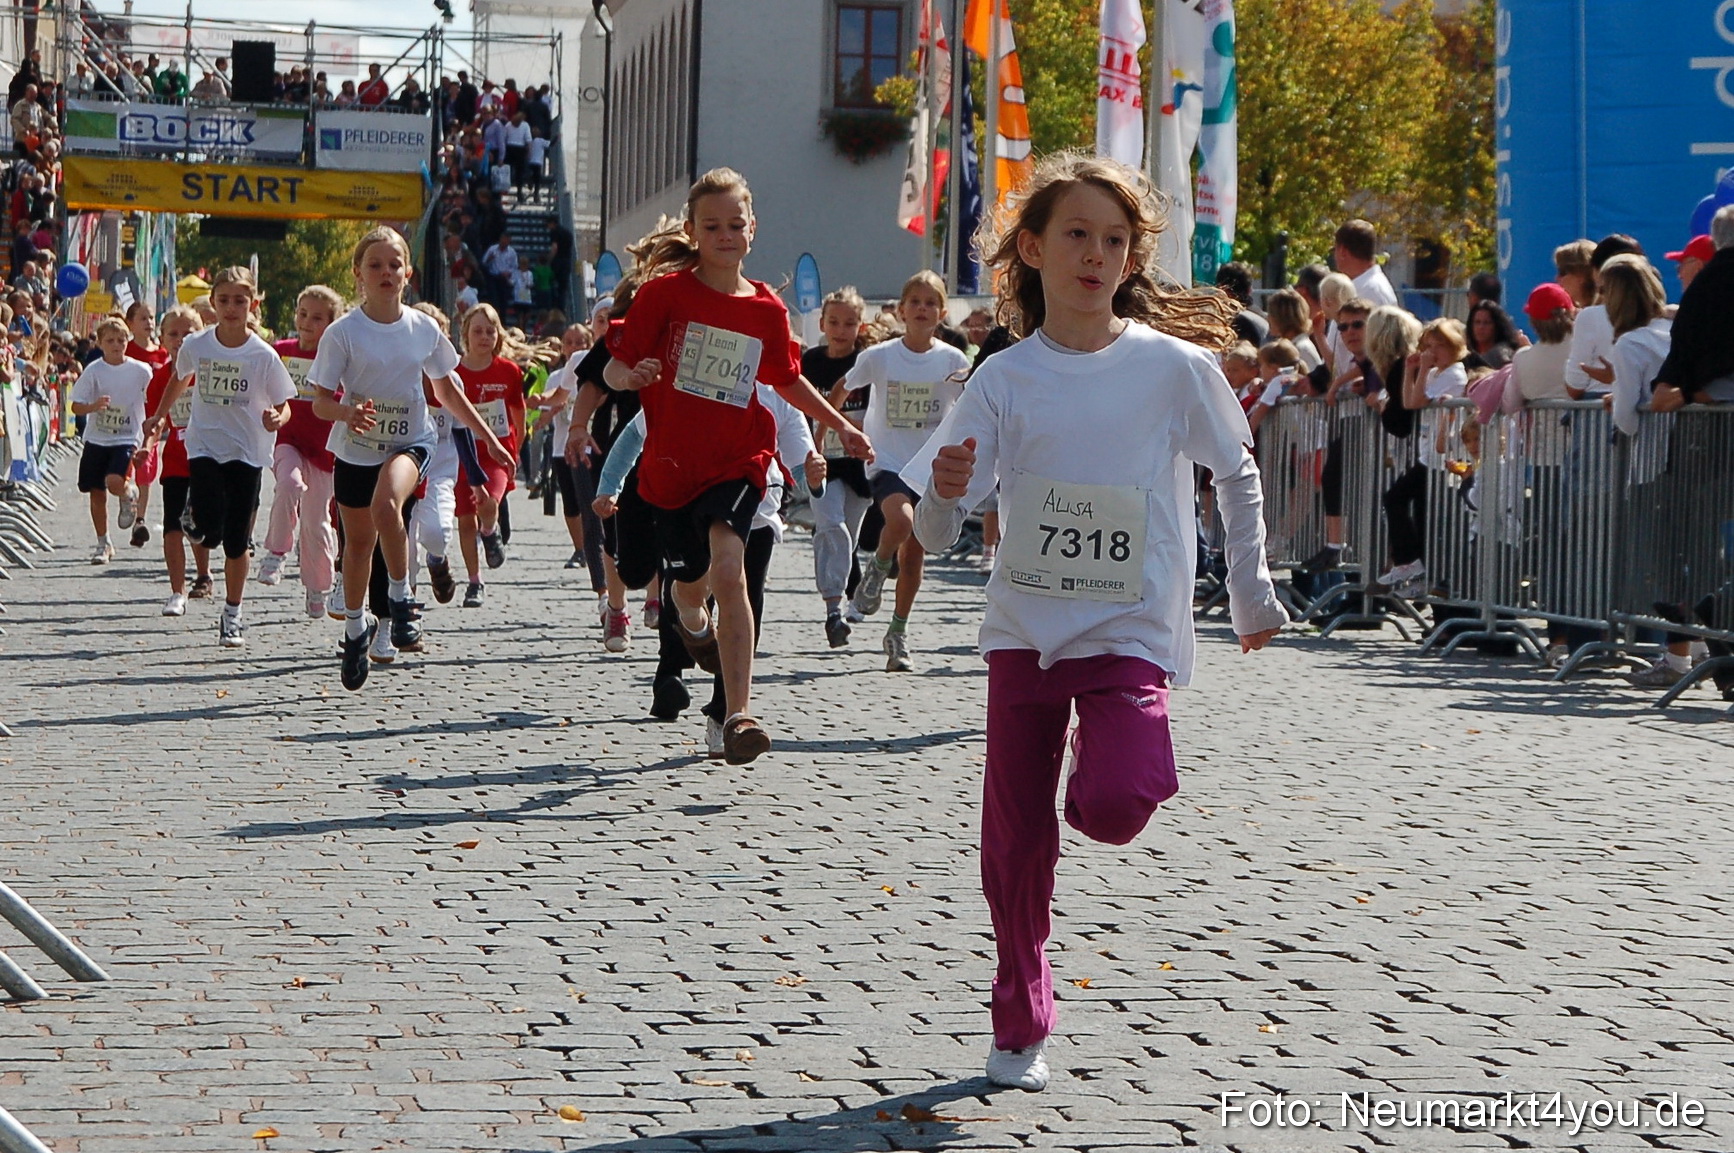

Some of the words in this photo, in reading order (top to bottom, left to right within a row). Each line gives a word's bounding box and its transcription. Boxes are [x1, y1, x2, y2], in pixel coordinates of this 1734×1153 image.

[119, 113, 256, 146] BOCK
[344, 129, 425, 146] PFLEIDERER
[181, 172, 305, 204] START
[211, 362, 239, 374] Sandra
[704, 354, 751, 385] 7042
[211, 376, 249, 392] 7169
[902, 385, 930, 395] Teresa
[373, 402, 409, 415] atharina
[903, 399, 941, 414] 7155
[105, 414, 131, 425] 7164
[371, 416, 409, 436] 168
[1038, 523, 1131, 562] 7318
[1076, 578, 1126, 591] PFLEIDERER
